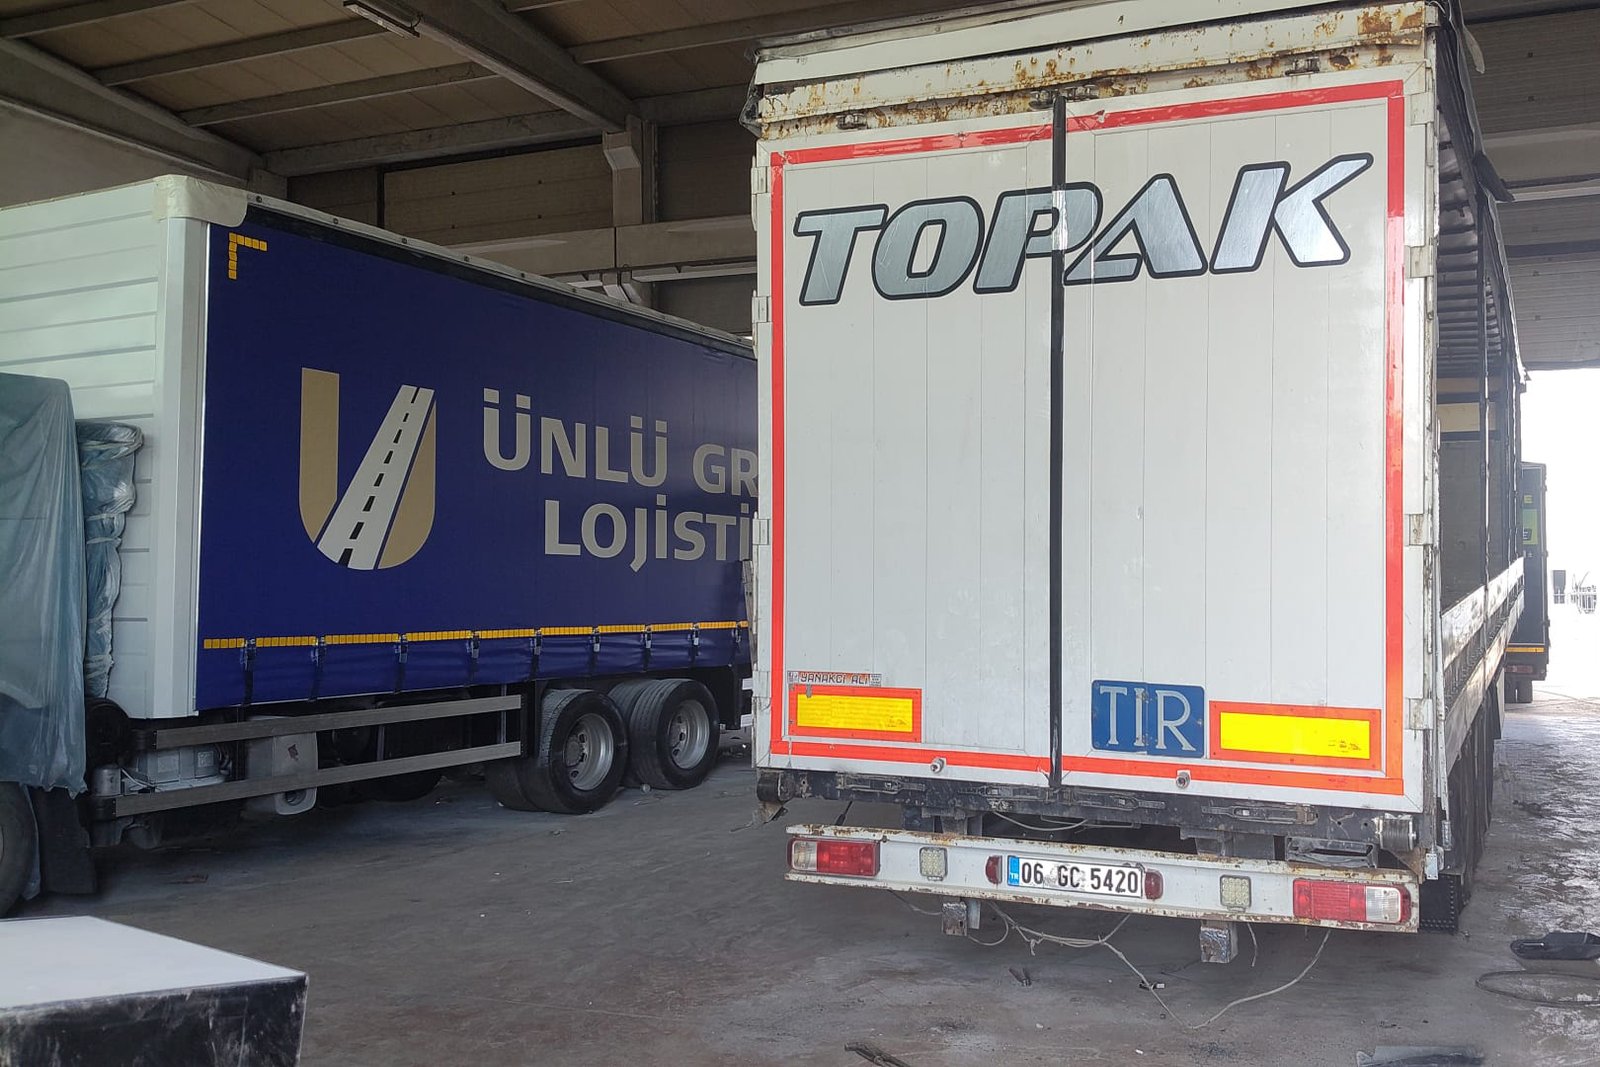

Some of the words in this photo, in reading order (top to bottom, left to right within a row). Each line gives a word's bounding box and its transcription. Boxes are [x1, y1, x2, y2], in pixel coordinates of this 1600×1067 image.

[793, 152, 1374, 306] TOPAK
[483, 387, 668, 488] ÜNLÜ
[1100, 685, 1196, 751] TIR
[1021, 862, 1044, 885] 06
[1057, 865, 1080, 888] GC
[1090, 868, 1138, 894] 5420
